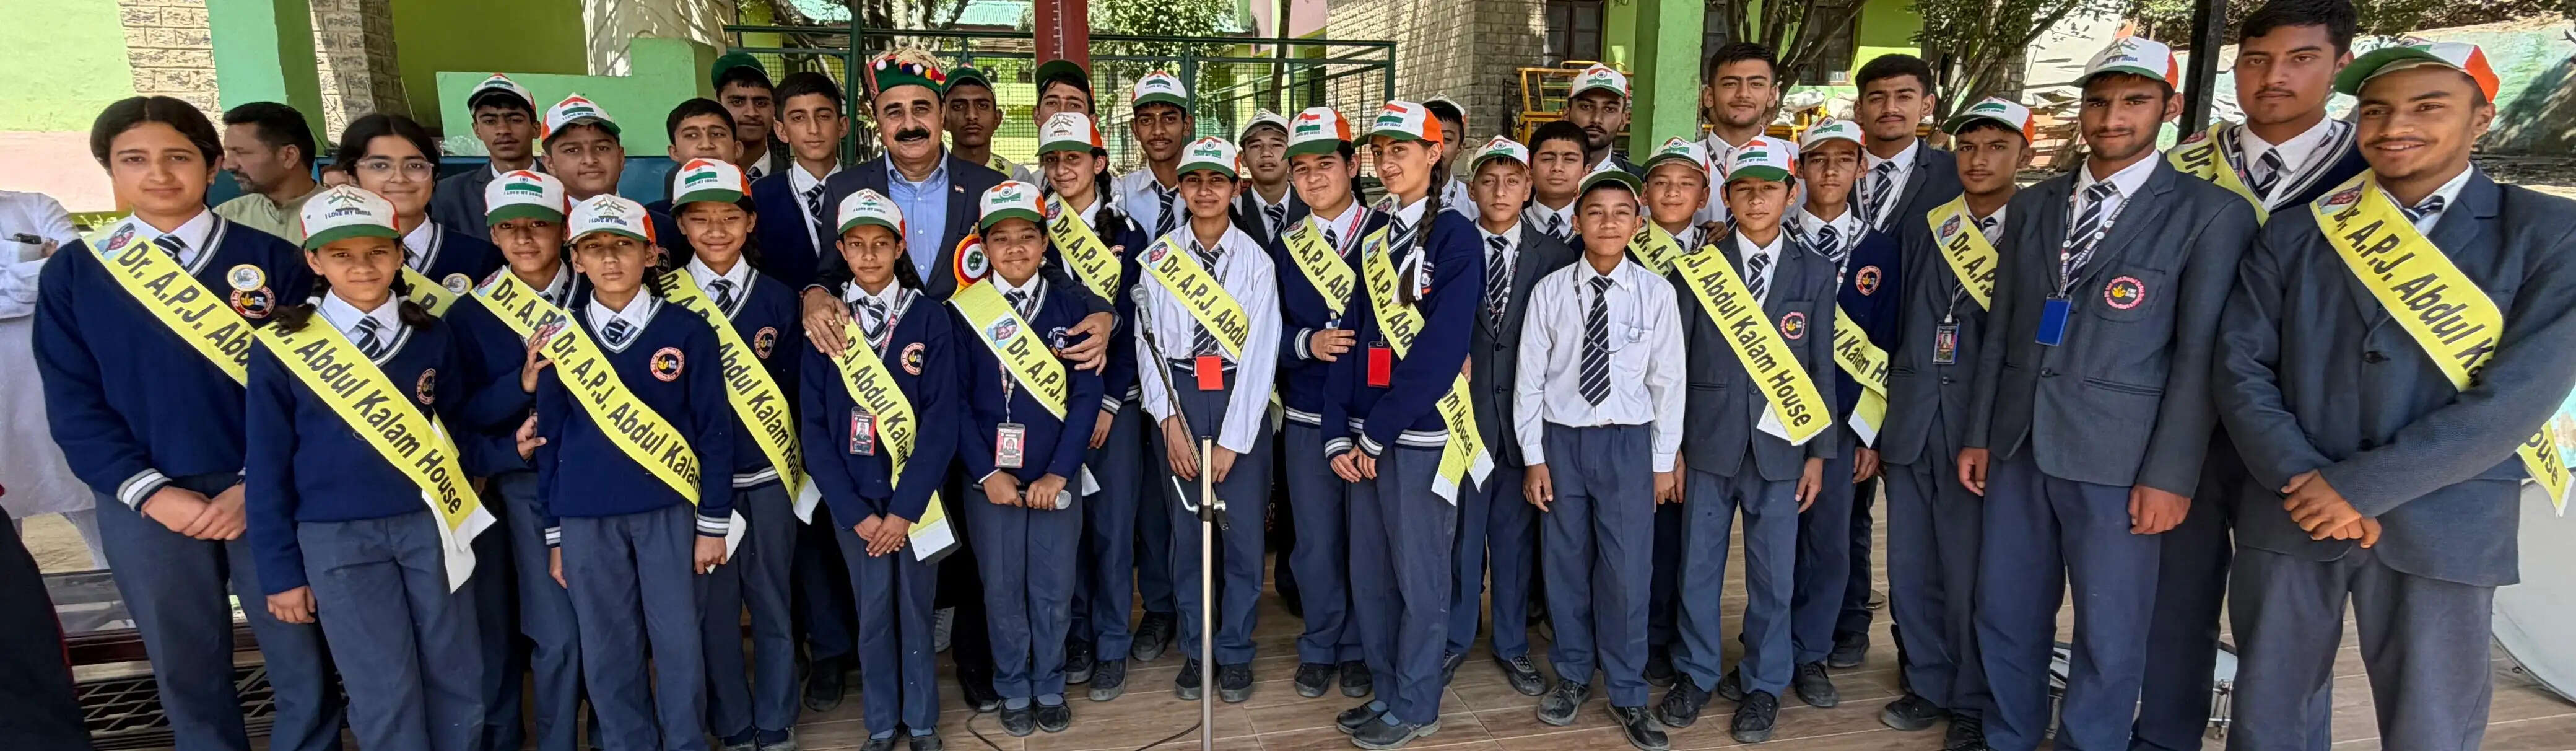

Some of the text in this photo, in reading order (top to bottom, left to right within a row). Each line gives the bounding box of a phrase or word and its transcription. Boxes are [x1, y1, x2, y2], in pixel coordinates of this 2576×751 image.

[1051, 214, 1072, 242] Dr.
[1066, 235, 1107, 279] A.P.J.
[1290, 226, 1308, 248] Dr.
[1299, 239, 1333, 281] A.P.J.
[1633, 229, 1652, 252] Dr.
[1949, 231, 1971, 261] Dr.
[117, 240, 152, 279] Dr.
[144, 270, 218, 330] A.P.J.
[491, 277, 518, 312] Dr.
[1159, 254, 1181, 282] Dr.
[1177, 273, 1219, 316] A.P.J.
[2344, 219, 2416, 281] A.P.J.
[2390, 273, 2486, 346] Abdul
[659, 273, 681, 297] Dr.
[720, 341, 762, 396] Abdul
[747, 389, 789, 449] Kalam
[1006, 335, 1030, 366] Dr.
[1025, 359, 1065, 402] A.P.J.
[1698, 271, 1746, 320] Abdul
[1730, 315, 1777, 374] Kalam
[1767, 369, 1811, 427] House
[552, 331, 577, 366] Dr.
[570, 357, 616, 411] A.P.J.
[607, 402, 669, 455] Abdul
[659, 440, 702, 496] Kalam
[850, 364, 897, 416] Abdul
[293, 338, 370, 400] Abdul
[352, 389, 421, 459] Kalam
[414, 449, 462, 514] House
[1451, 405, 1473, 457] House
